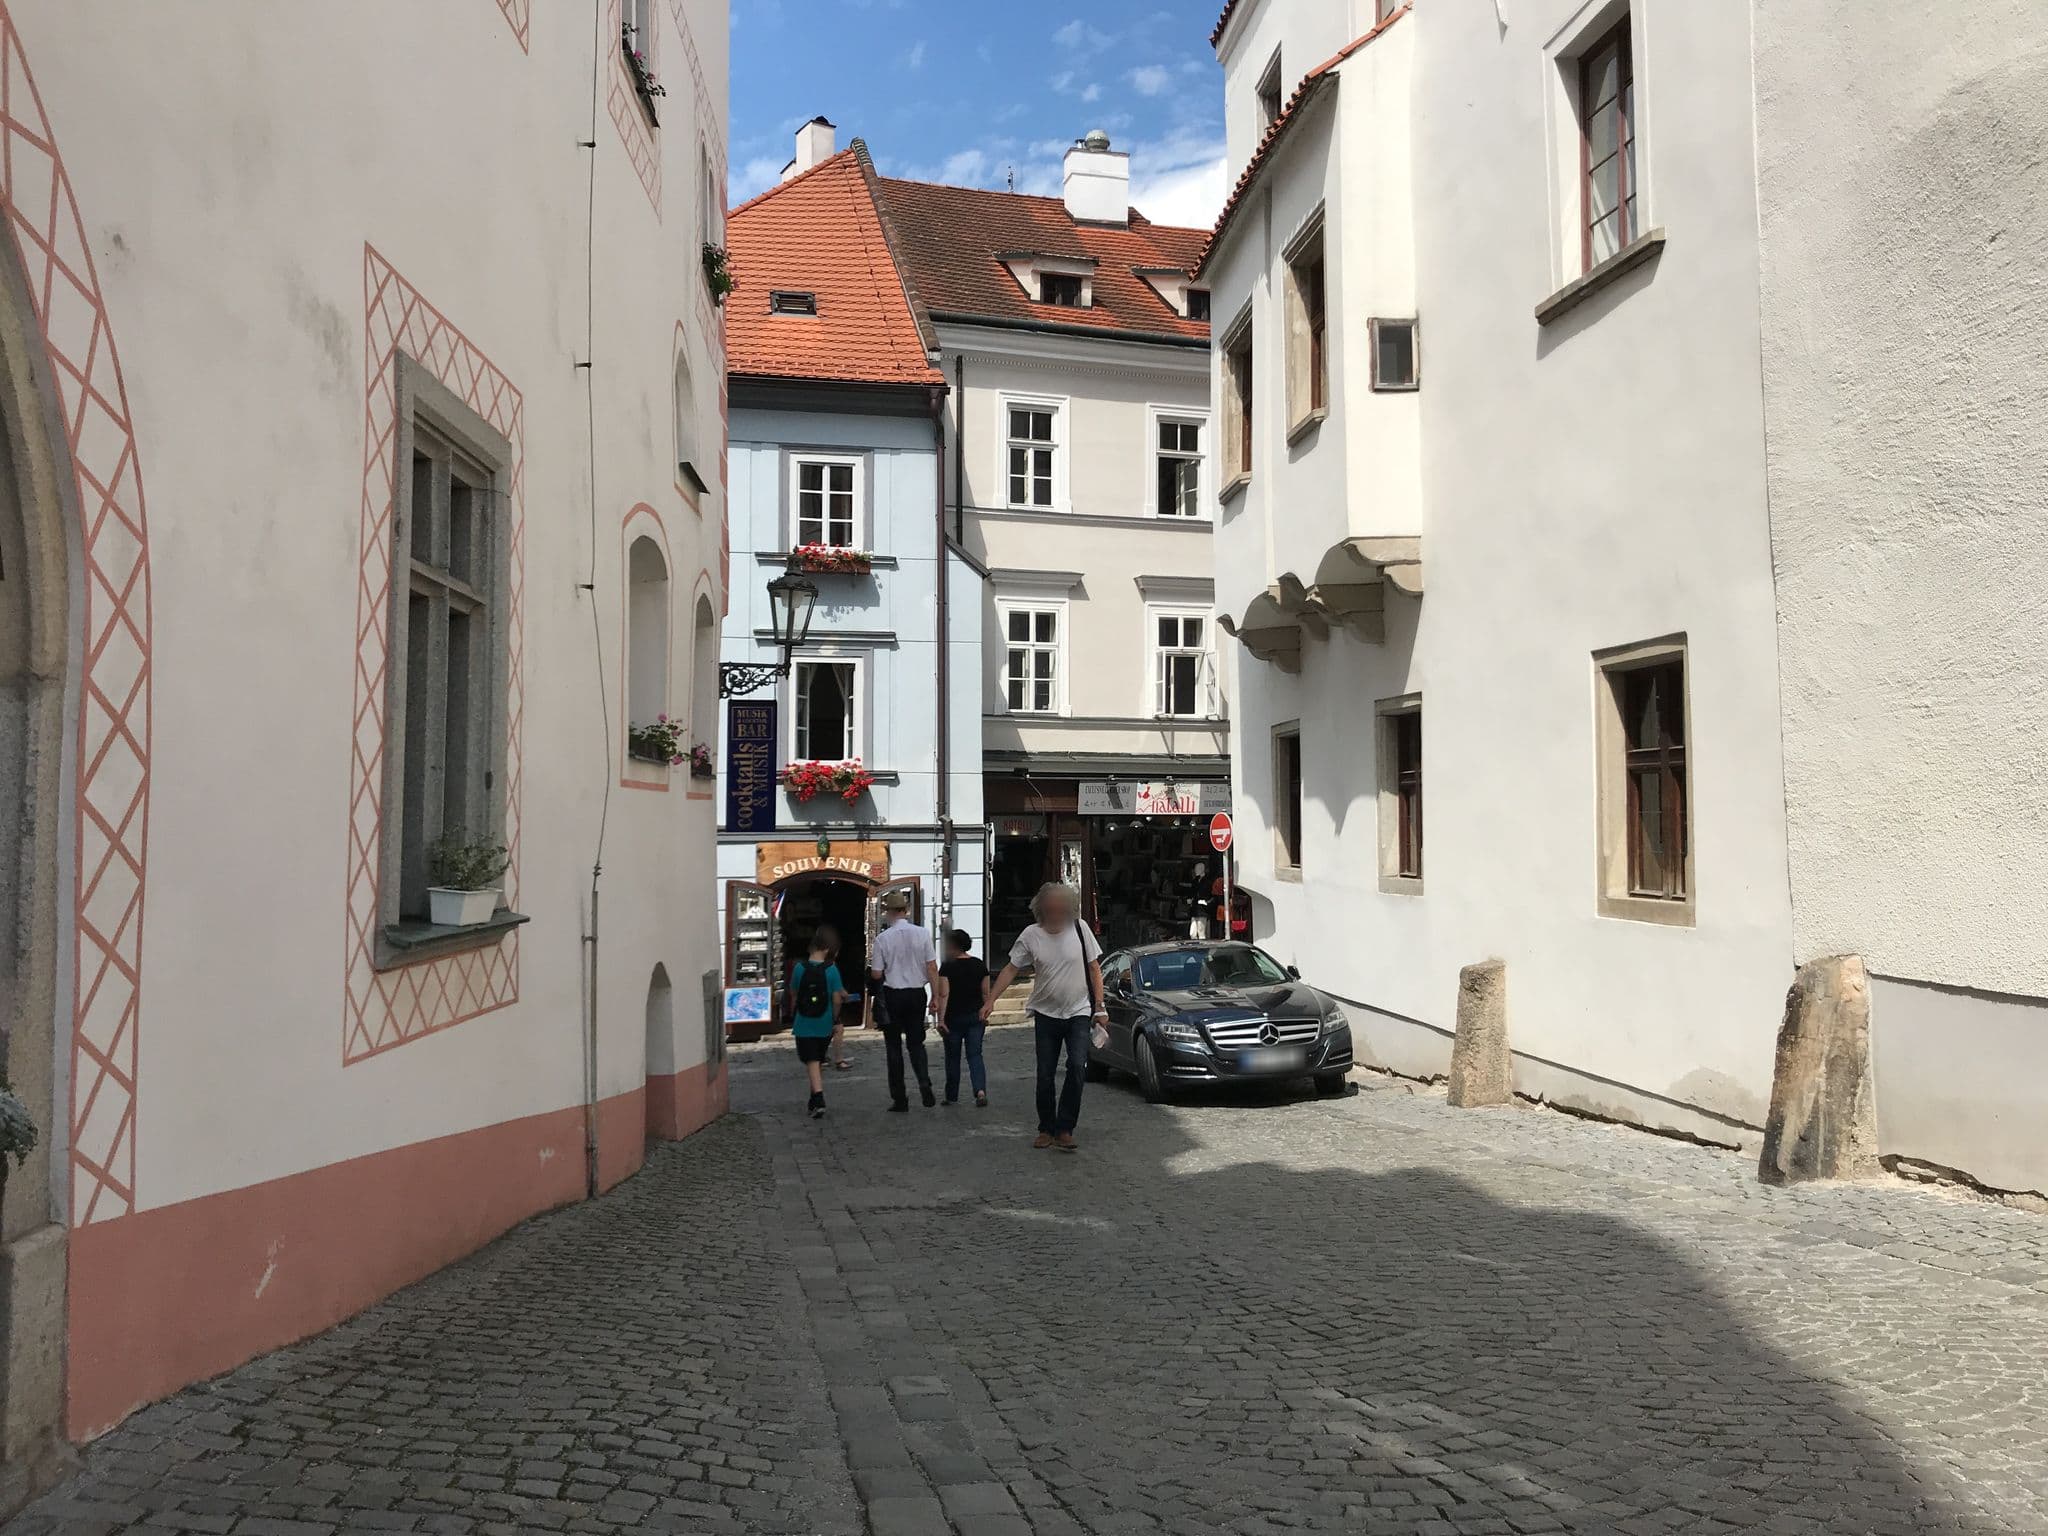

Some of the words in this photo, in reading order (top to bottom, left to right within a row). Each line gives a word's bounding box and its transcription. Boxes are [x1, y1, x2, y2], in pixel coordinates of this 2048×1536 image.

[736, 709, 768, 718] MUSIK
[737, 724, 768, 737] BAR
[753, 744, 769, 792] MUSIK
[732, 743, 754, 828] cocktails
[753, 796, 769, 808] &
[772, 856, 872, 878] SOUVENIR
